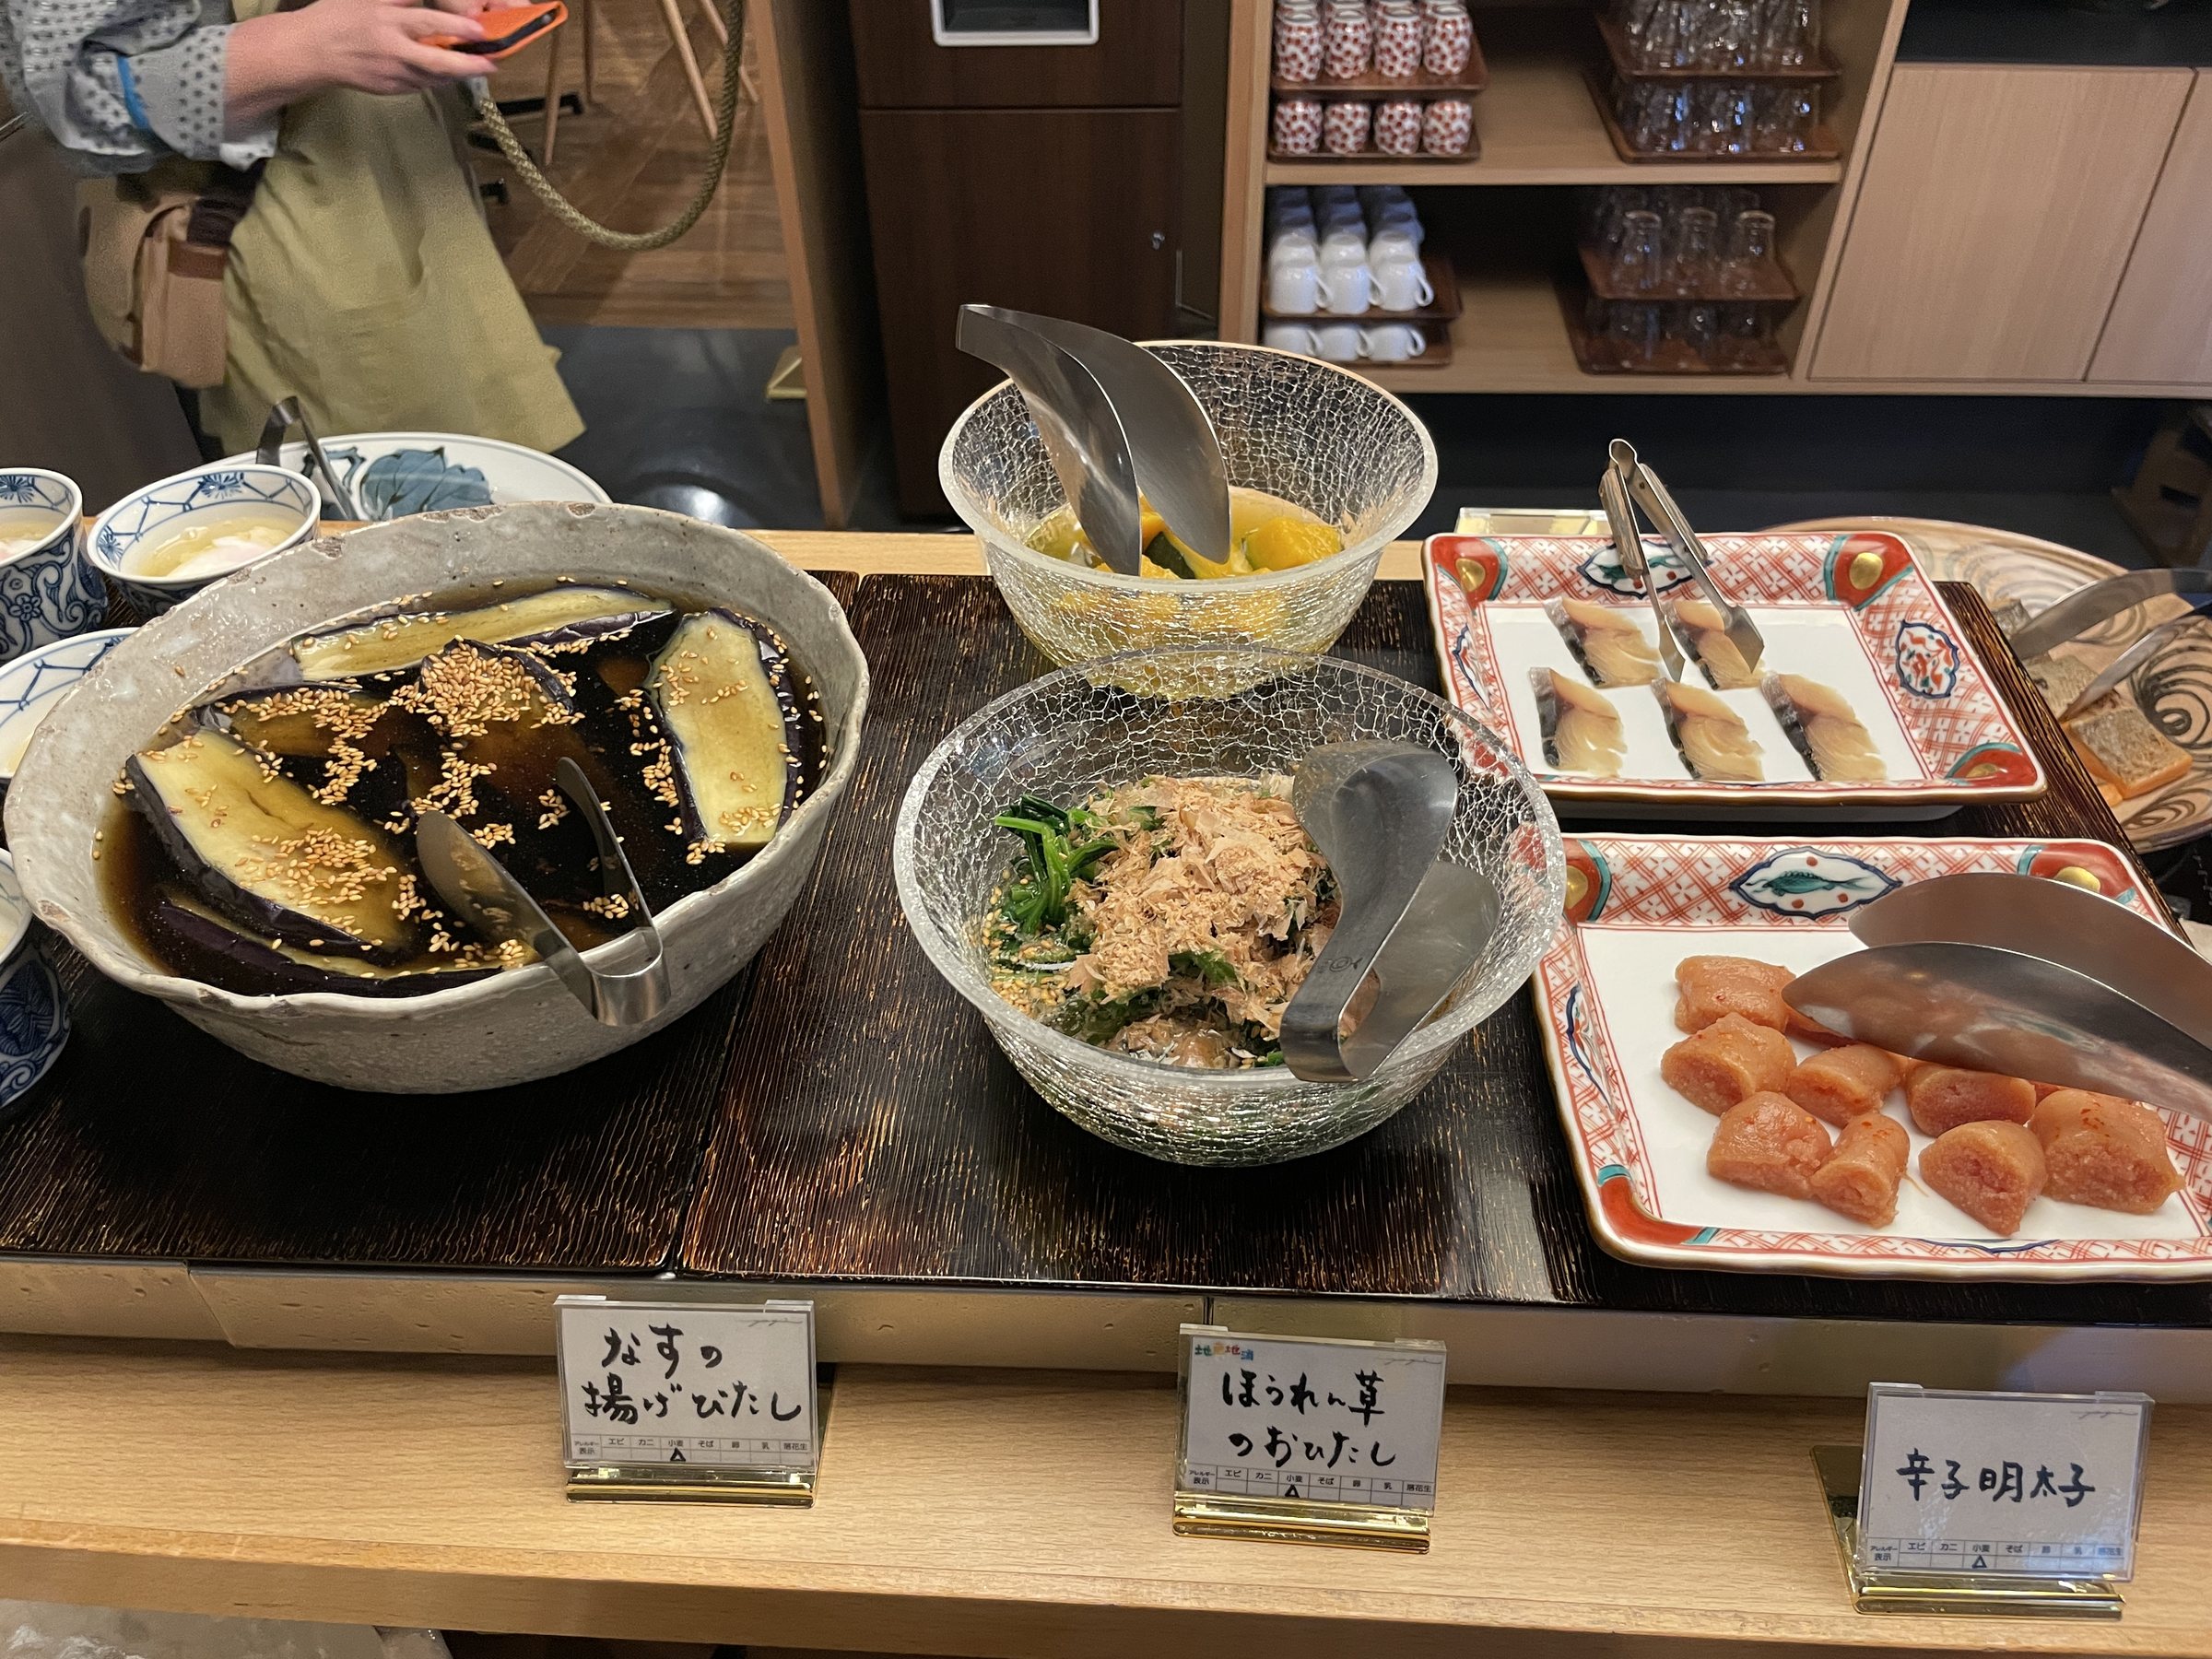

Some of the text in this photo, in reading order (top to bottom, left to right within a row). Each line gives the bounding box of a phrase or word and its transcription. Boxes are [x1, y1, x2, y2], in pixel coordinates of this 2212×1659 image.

[601, 1323, 723, 1379] なすの
[581, 1371, 802, 1425] 揚げびたし
[1222, 1368, 1385, 1427] ほうれん草
[1229, 1426, 1396, 1468] のおひたし
[1255, 1472, 1272, 1480] カニ
[1896, 1447, 2096, 1509] 辛子明太子
[1941, 1543, 1958, 1551] カニ
